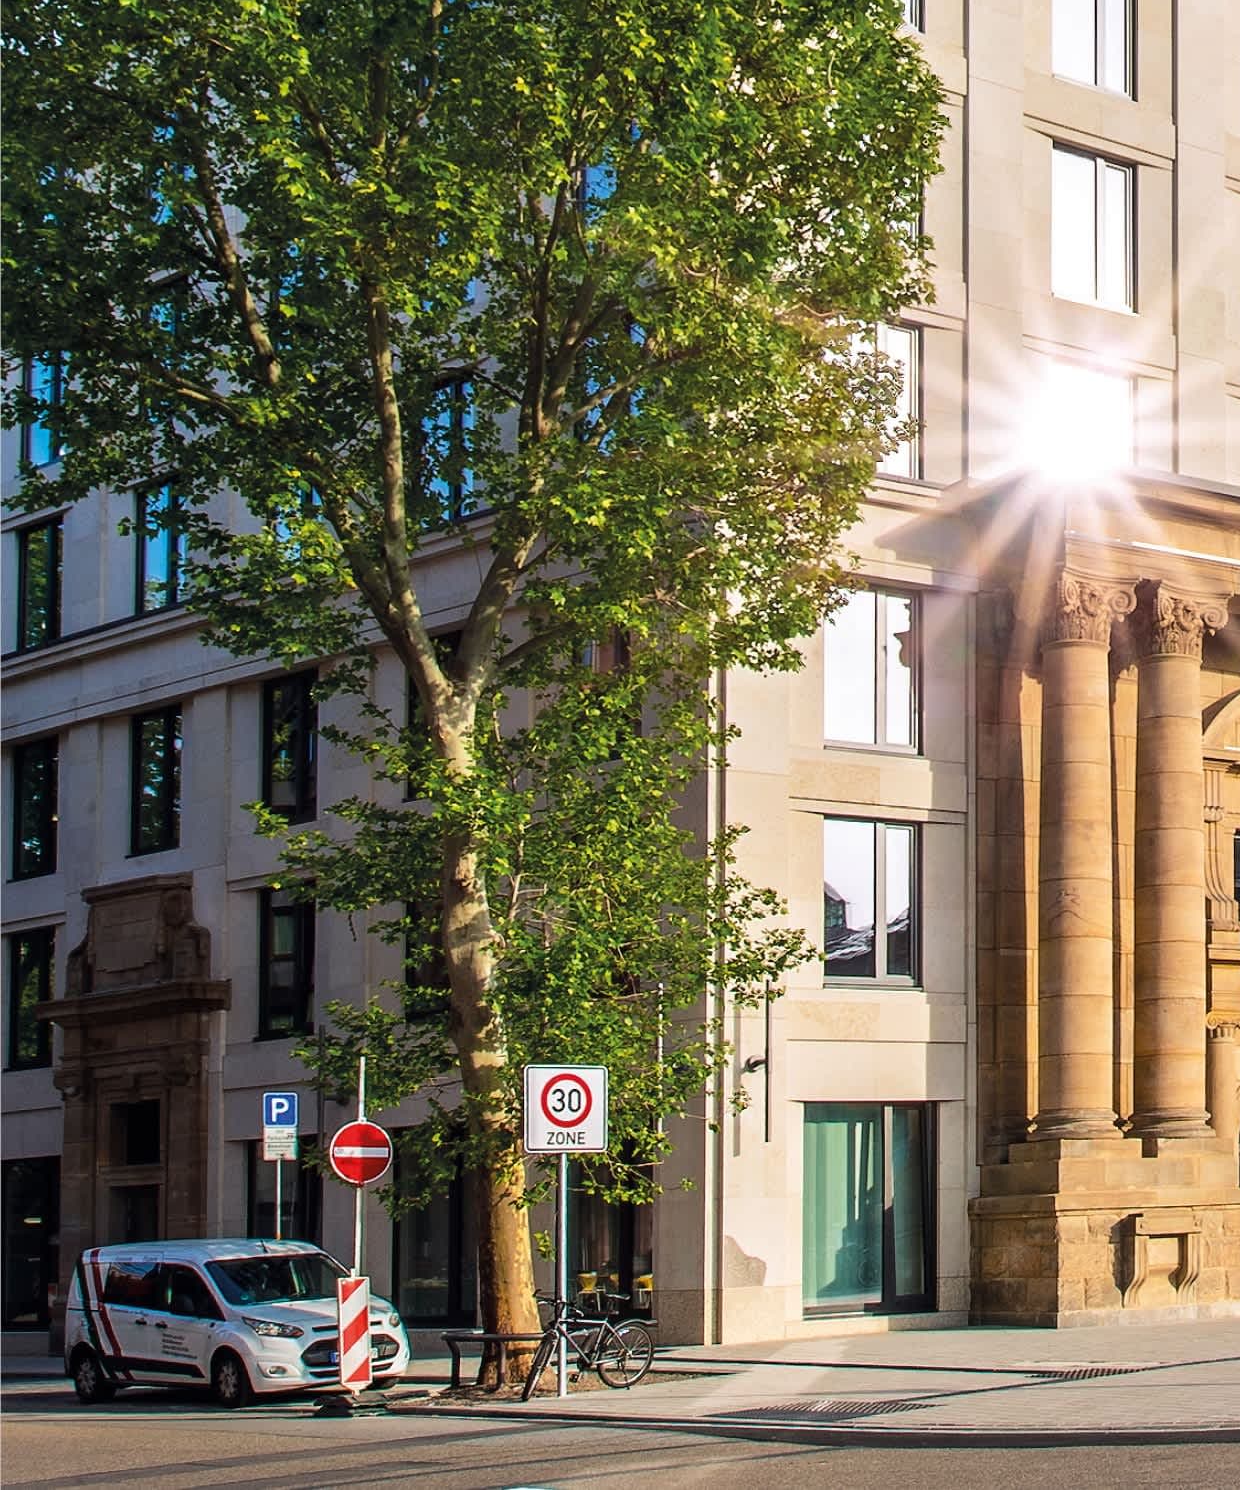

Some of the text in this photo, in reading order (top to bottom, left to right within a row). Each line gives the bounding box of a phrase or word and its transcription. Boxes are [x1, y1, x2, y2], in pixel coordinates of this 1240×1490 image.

[271, 1098, 289, 1122] P
[552, 1088, 581, 1113] 30
[546, 1131, 586, 1145] ZONE
